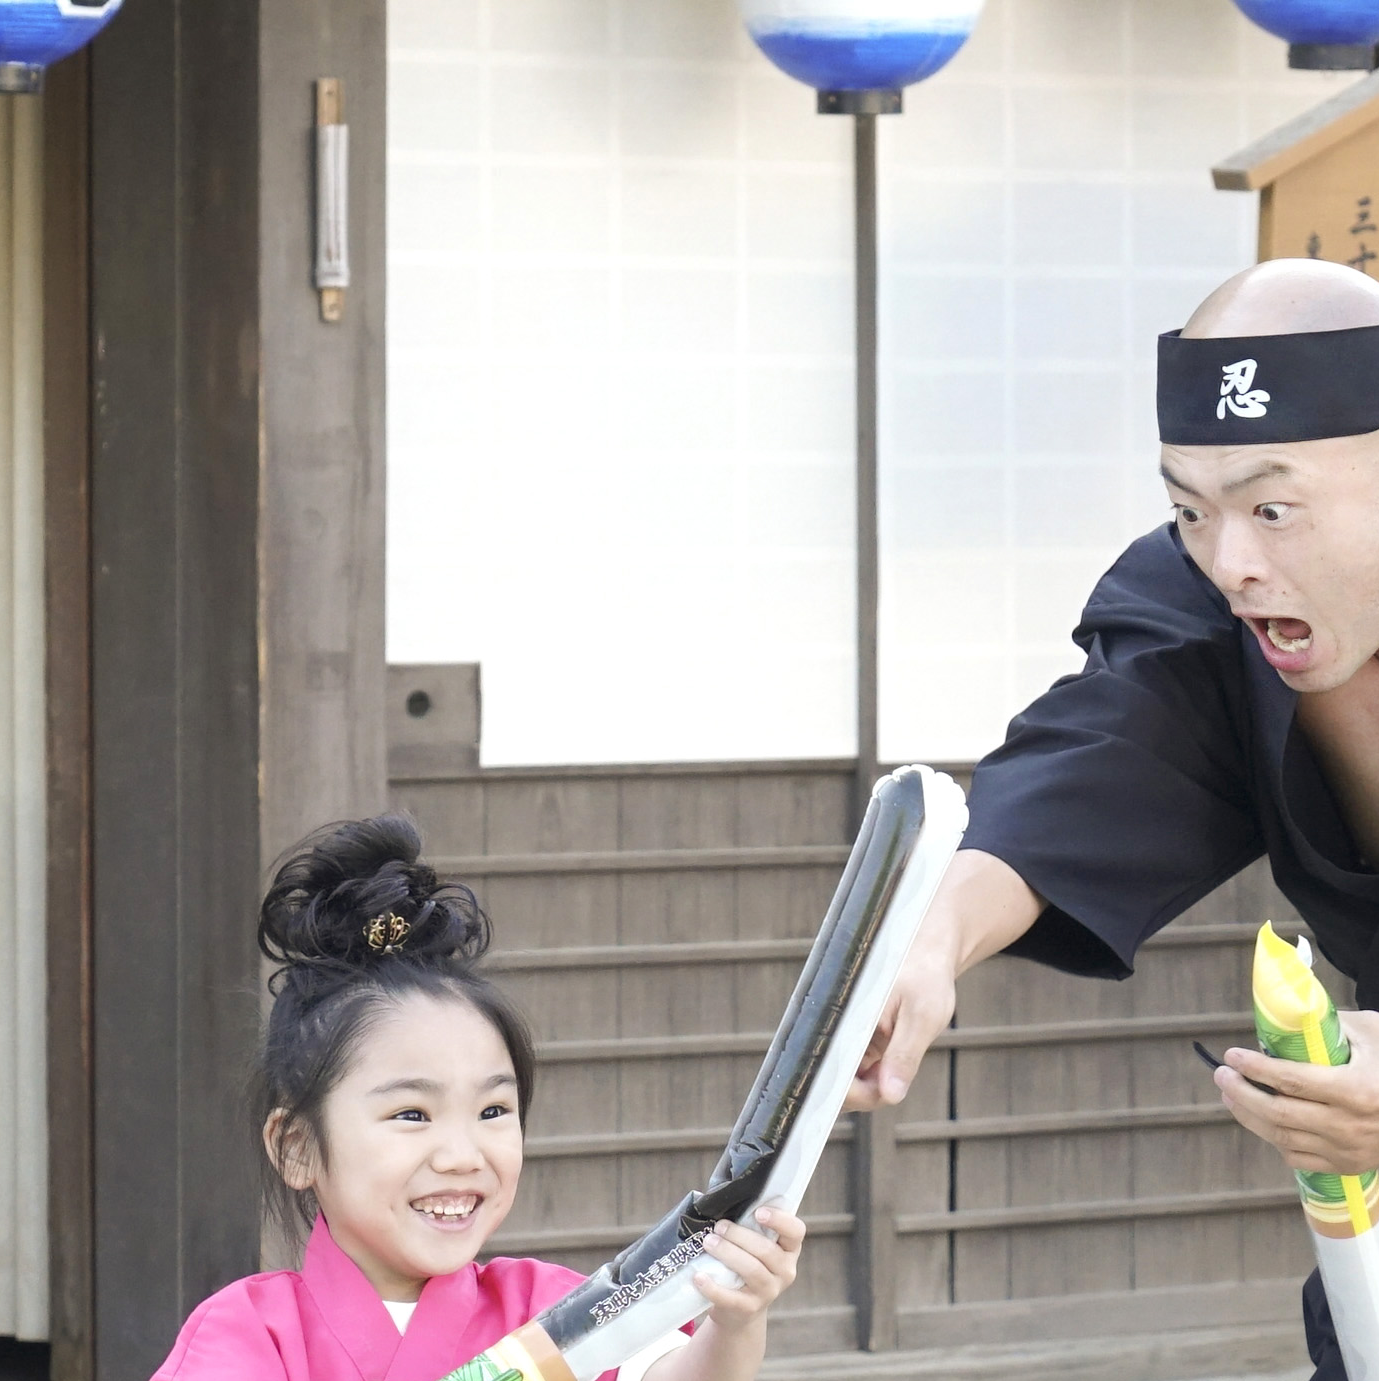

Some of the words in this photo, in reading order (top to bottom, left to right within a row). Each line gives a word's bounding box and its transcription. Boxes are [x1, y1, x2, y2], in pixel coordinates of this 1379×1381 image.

[1216, 358, 1271, 420] 忍
[589, 1226, 713, 1326] 東映太秦映画
